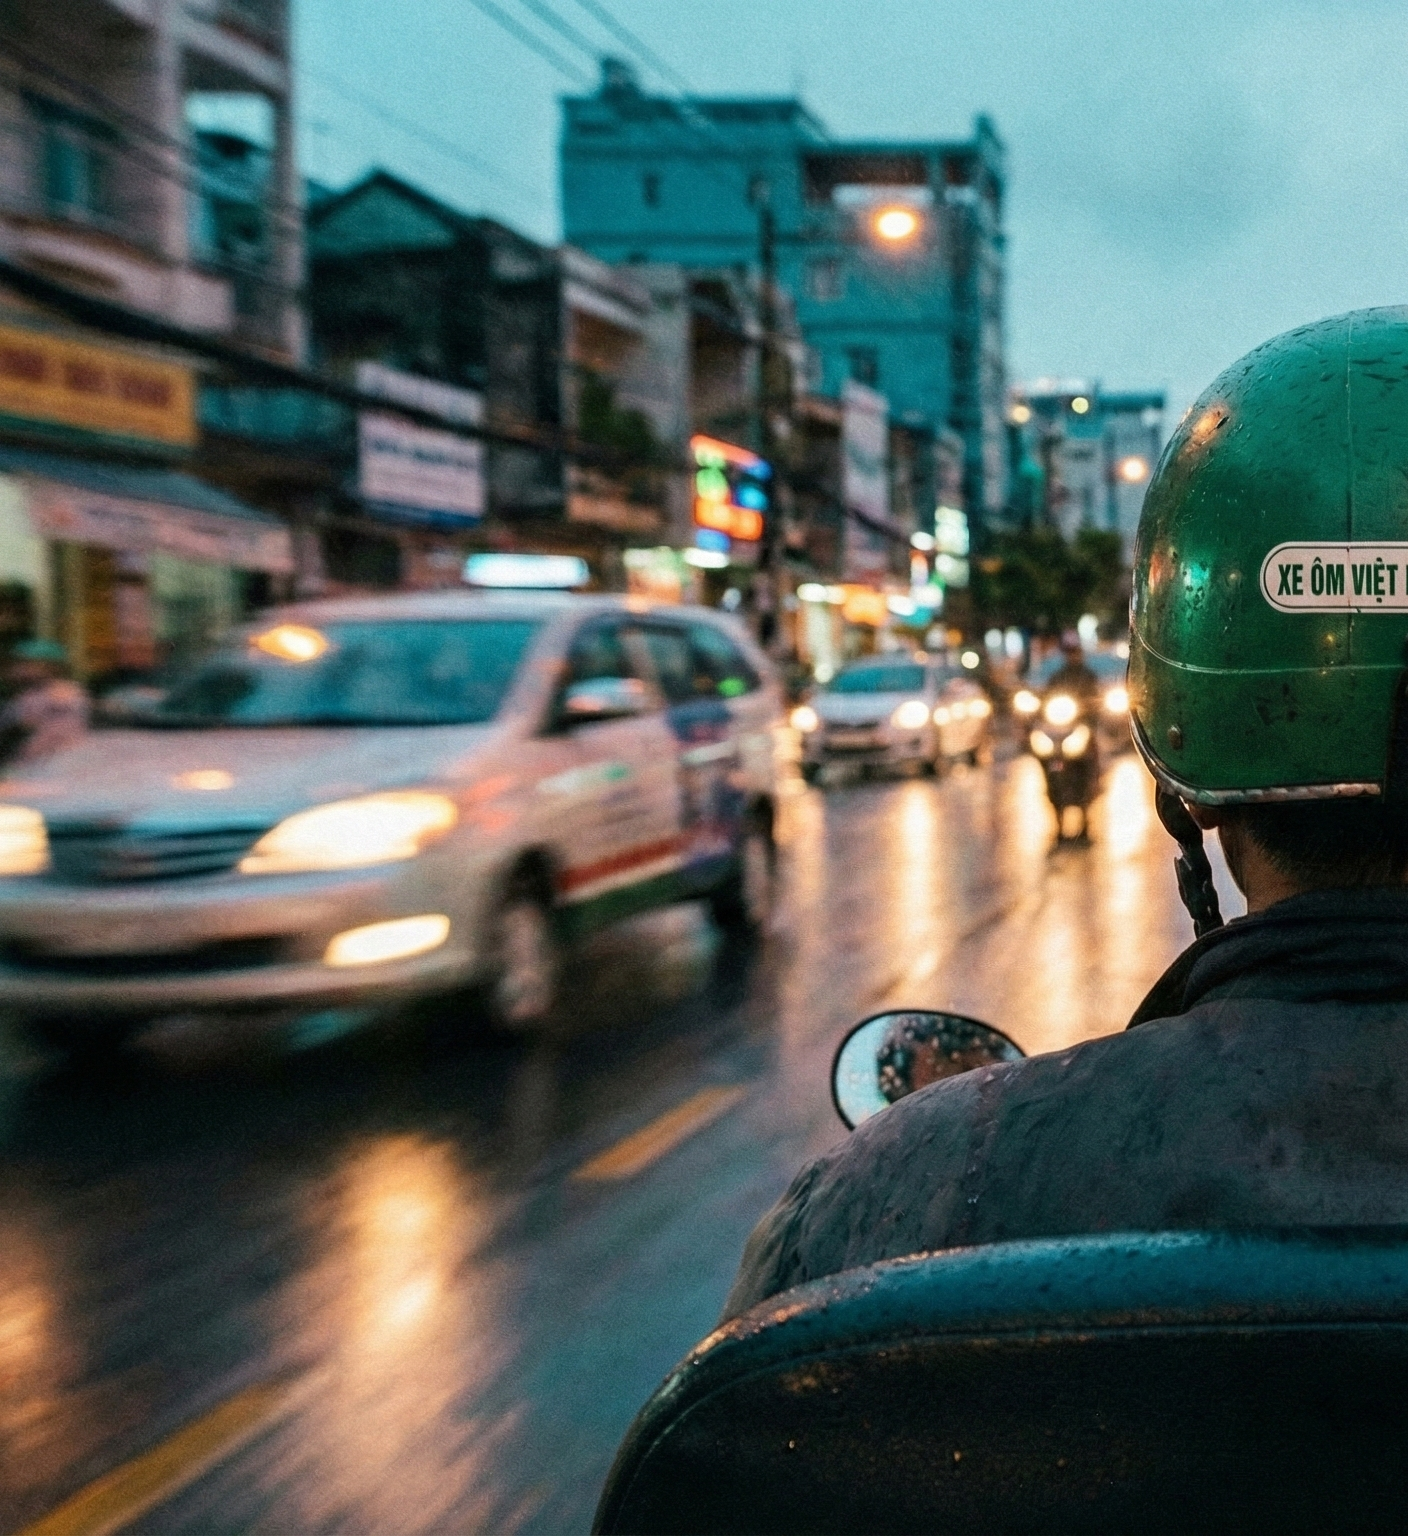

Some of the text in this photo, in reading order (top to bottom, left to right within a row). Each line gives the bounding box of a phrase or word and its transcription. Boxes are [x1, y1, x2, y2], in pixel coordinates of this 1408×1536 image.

[1278, 564, 1303, 595] XE
[1311, 557, 1344, 595] ÔM
[1351, 557, 1398, 603] VIỆT
